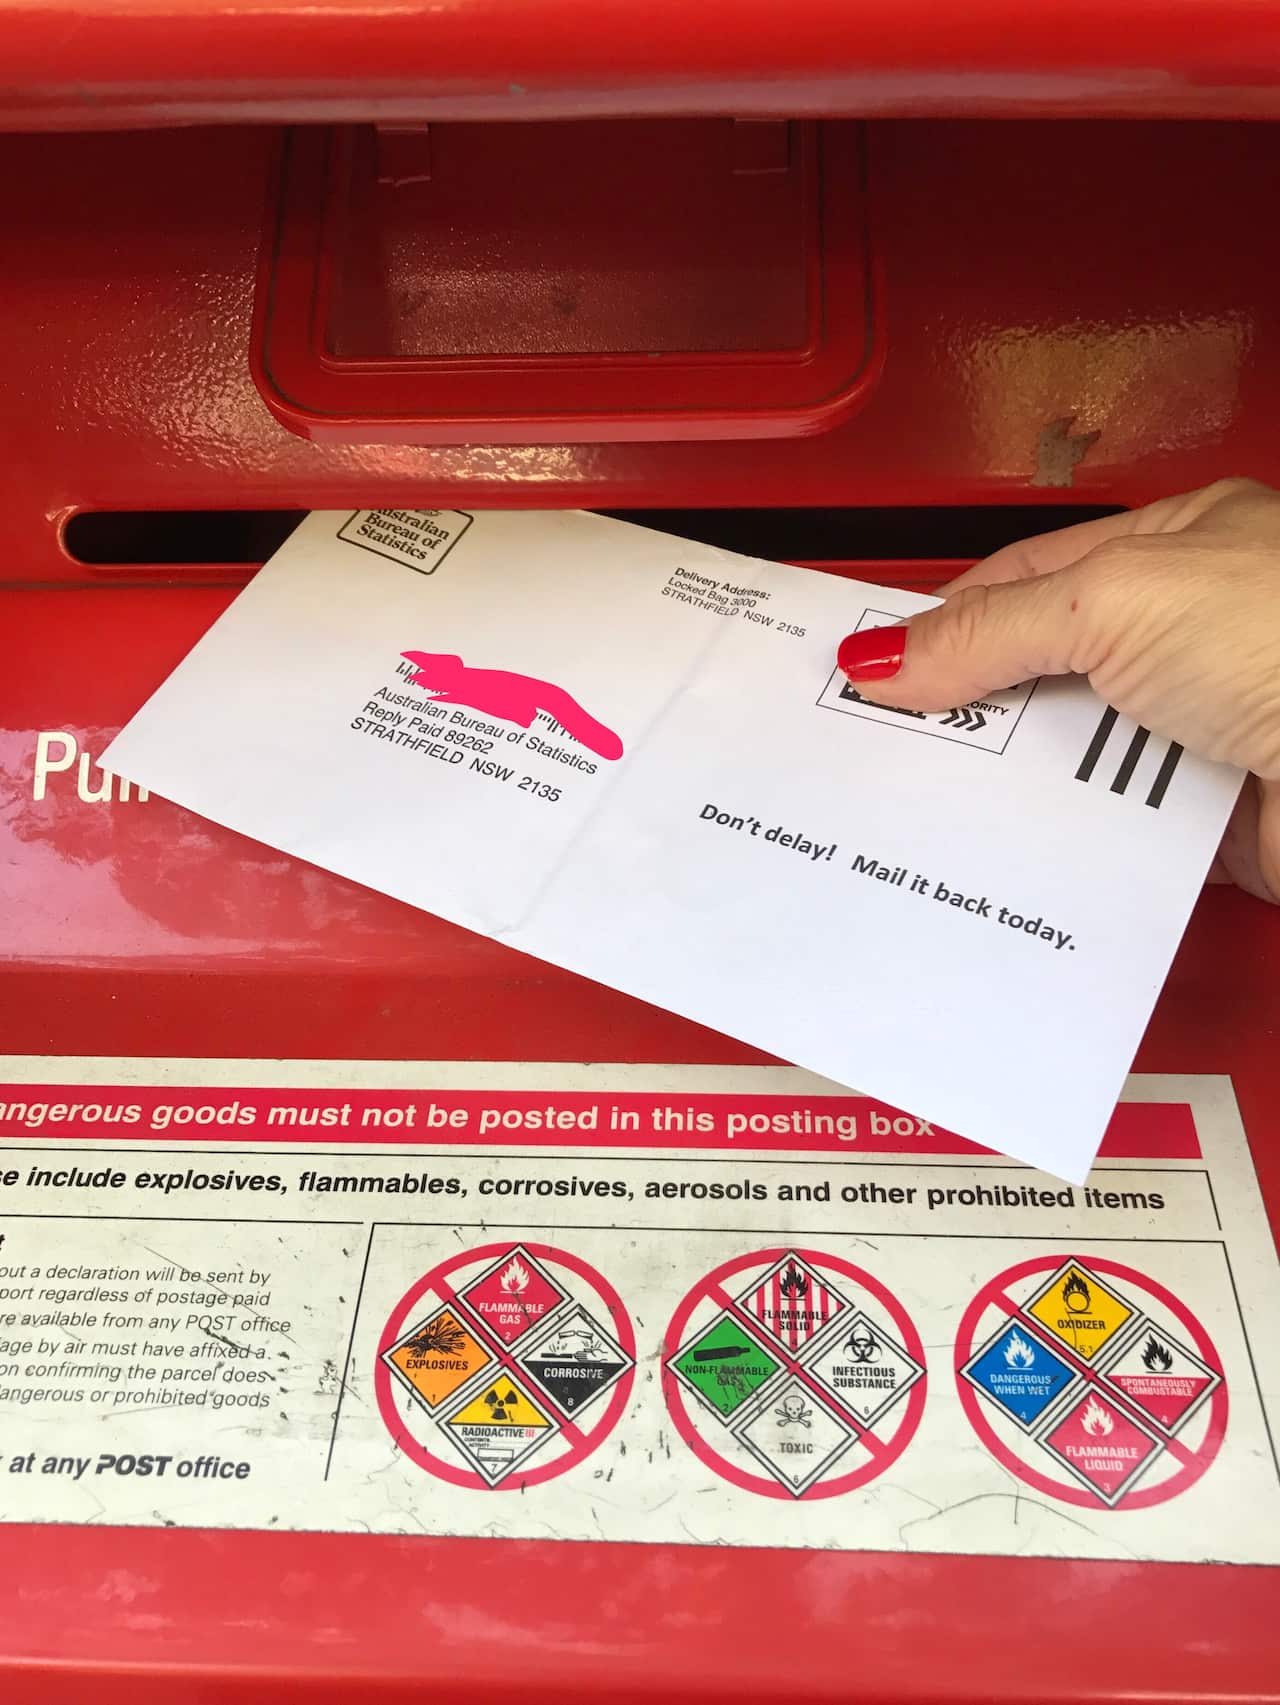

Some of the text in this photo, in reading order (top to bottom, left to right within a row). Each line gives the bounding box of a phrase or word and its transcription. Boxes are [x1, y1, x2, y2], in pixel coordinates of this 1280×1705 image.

[364, 512, 441, 550] Bureau of
[371, 509, 450, 541] ustralian
[356, 523, 428, 560] Statistics
[674, 567, 772, 601] Delivery Address:
[668, 576, 757, 608] Locked Bag 3000
[661, 586, 807, 638] STRATHFIELD NSW 2135
[968, 701, 1009, 716] ORITY
[362, 701, 495, 755] Reply Paid 89262
[374, 686, 598, 775] Australian Bureau of Statistics
[350, 716, 562, 802] STRATHFIELD NSW 2135
[33, 731, 149, 803] Pu
[699, 803, 1076, 951] Don’t delay! Mail it back today.
[150, 1102, 256, 1130] goods
[267, 1103, 350, 1127] must
[361, 1104, 415, 1128] not
[427, 1104, 469, 1129] be
[479, 1106, 598, 1134] posted
[610, 1106, 640, 1131] in
[653, 1107, 715, 1132] this
[727, 1108, 857, 1140] posting
[870, 1111, 935, 1136] box
[26, 1166, 126, 1188] include
[134, 1170, 289, 1195] explosives,
[299, 1172, 468, 1197] flammables,
[478, 1176, 634, 1201] corrosives,
[645, 1179, 767, 1201] aerosols
[777, 1181, 829, 1202] and
[840, 1183, 917, 1204] other
[928, 1185, 1075, 1210] prohibited
[1084, 1187, 1165, 1210] items
[30, 1267, 40, 1278] a
[46, 1265, 139, 1280] declaration
[146, 1267, 175, 1281] will
[180, 1268, 200, 1282] be
[206, 1270, 244, 1283] sent
[249, 1269, 271, 1286] by
[38, 1288, 128, 1304] regardless
[134, 1288, 154, 1302] of
[156, 1291, 228, 1307] postage
[232, 1291, 271, 1308] paid
[478, 1302, 544, 1314] FLAMMABLE
[762, 1309, 827, 1321] FLAMMABLE
[21, 1311, 96, 1327] available
[102, 1312, 143, 1328] from
[149, 1316, 181, 1332] any
[185, 1314, 237, 1331] POST
[241, 1316, 291, 1332] office
[499, 1314, 521, 1325] GAS
[778, 1320, 811, 1331] SOLID
[1057, 1319, 1106, 1330] OXIDIZER
[505, 1331, 511, 1340] 2
[38, 1338, 60, 1357] by
[64, 1339, 87, 1354] air
[91, 1340, 137, 1356] must
[142, 1341, 184, 1356] have
[189, 1342, 250, 1359] affixed
[406, 1359, 469, 1371] EXPLOSIVES
[832, 1366, 896, 1378] INFECTIOUS
[25, 1362, 121, 1382] confirming
[127, 1365, 156, 1380] the
[161, 1366, 217, 1383] parcel
[222, 1366, 266, 1383] does
[543, 1367, 604, 1380] CORROSIVE
[990, 1374, 1051, 1385] DANGEROUS
[833, 1377, 896, 1389] SUBSTANCE
[994, 1384, 1050, 1396] WHEN WET
[1121, 1378, 1196, 1388] SPONTANEOUSLY
[90, 1390, 110, 1402] or
[113, 1388, 208, 1406] prohibited
[212, 1391, 271, 1409] goods
[567, 1397, 574, 1406] 8
[722, 1403, 729, 1412] 2
[863, 1406, 870, 1415] 6
[1020, 1411, 1027, 1420] 4
[779, 1442, 813, 1454] TOXIC
[1066, 1445, 1139, 1459] FLAMMABLE
[9, 1452, 251, 1480] at any POST office
[491, 1463, 498, 1473] 7
[1084, 1460, 1123, 1472] LIQUID
[1103, 1483, 1111, 1491] 3
